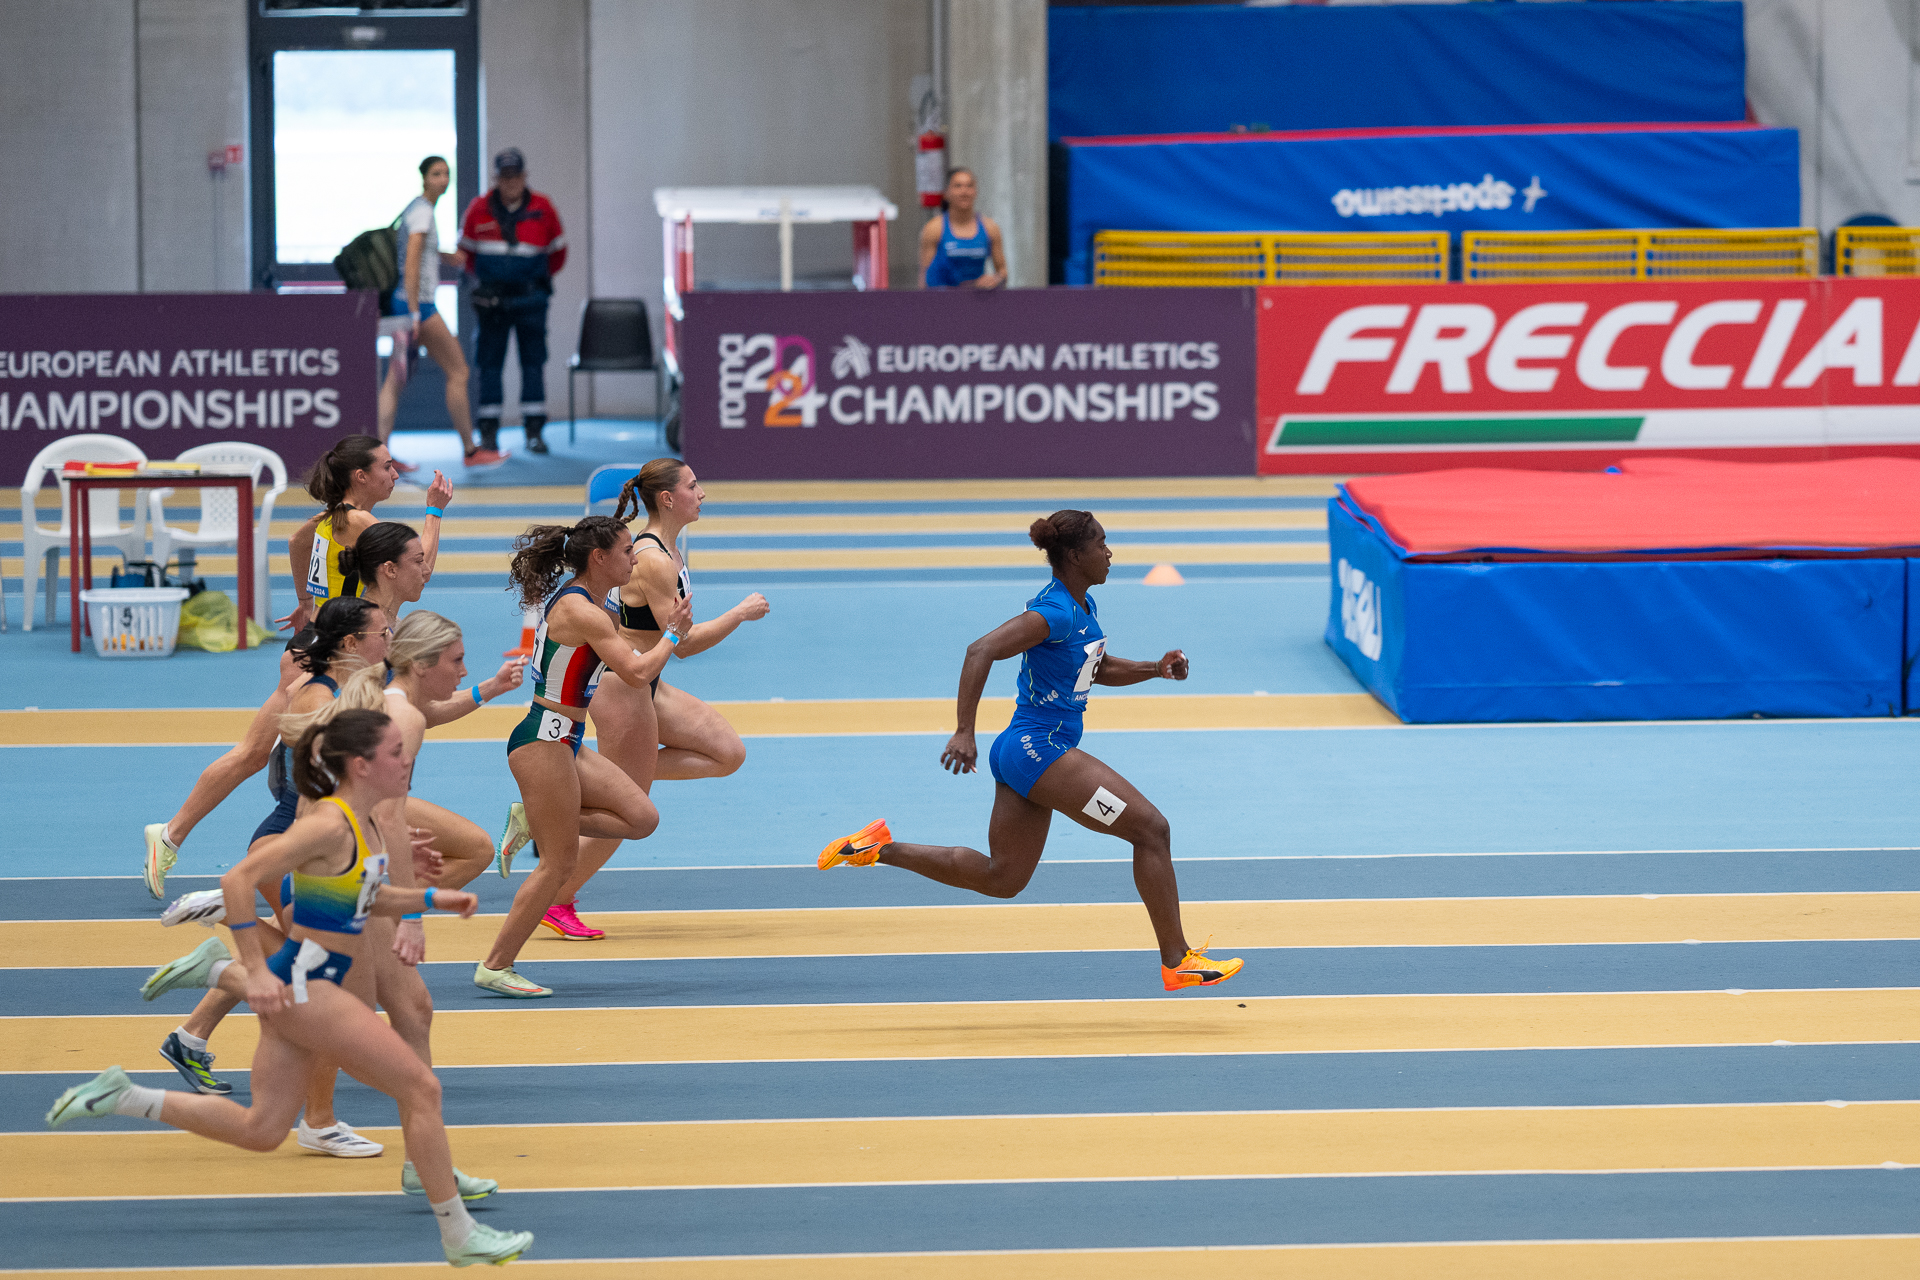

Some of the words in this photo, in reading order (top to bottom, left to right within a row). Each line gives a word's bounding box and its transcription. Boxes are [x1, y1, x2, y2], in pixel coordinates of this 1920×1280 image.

[877, 344, 1044, 371] EUROPEAN
[1052, 342, 1220, 369] ATHLETICS
[1296, 297, 1920, 395] FRECCIA
[170, 348, 340, 376] ATHLETICS
[829, 381, 1220, 426] CHAMPIONSHIPS
[548, 718, 562, 739] 3
[1096, 799, 1116, 817] 4
